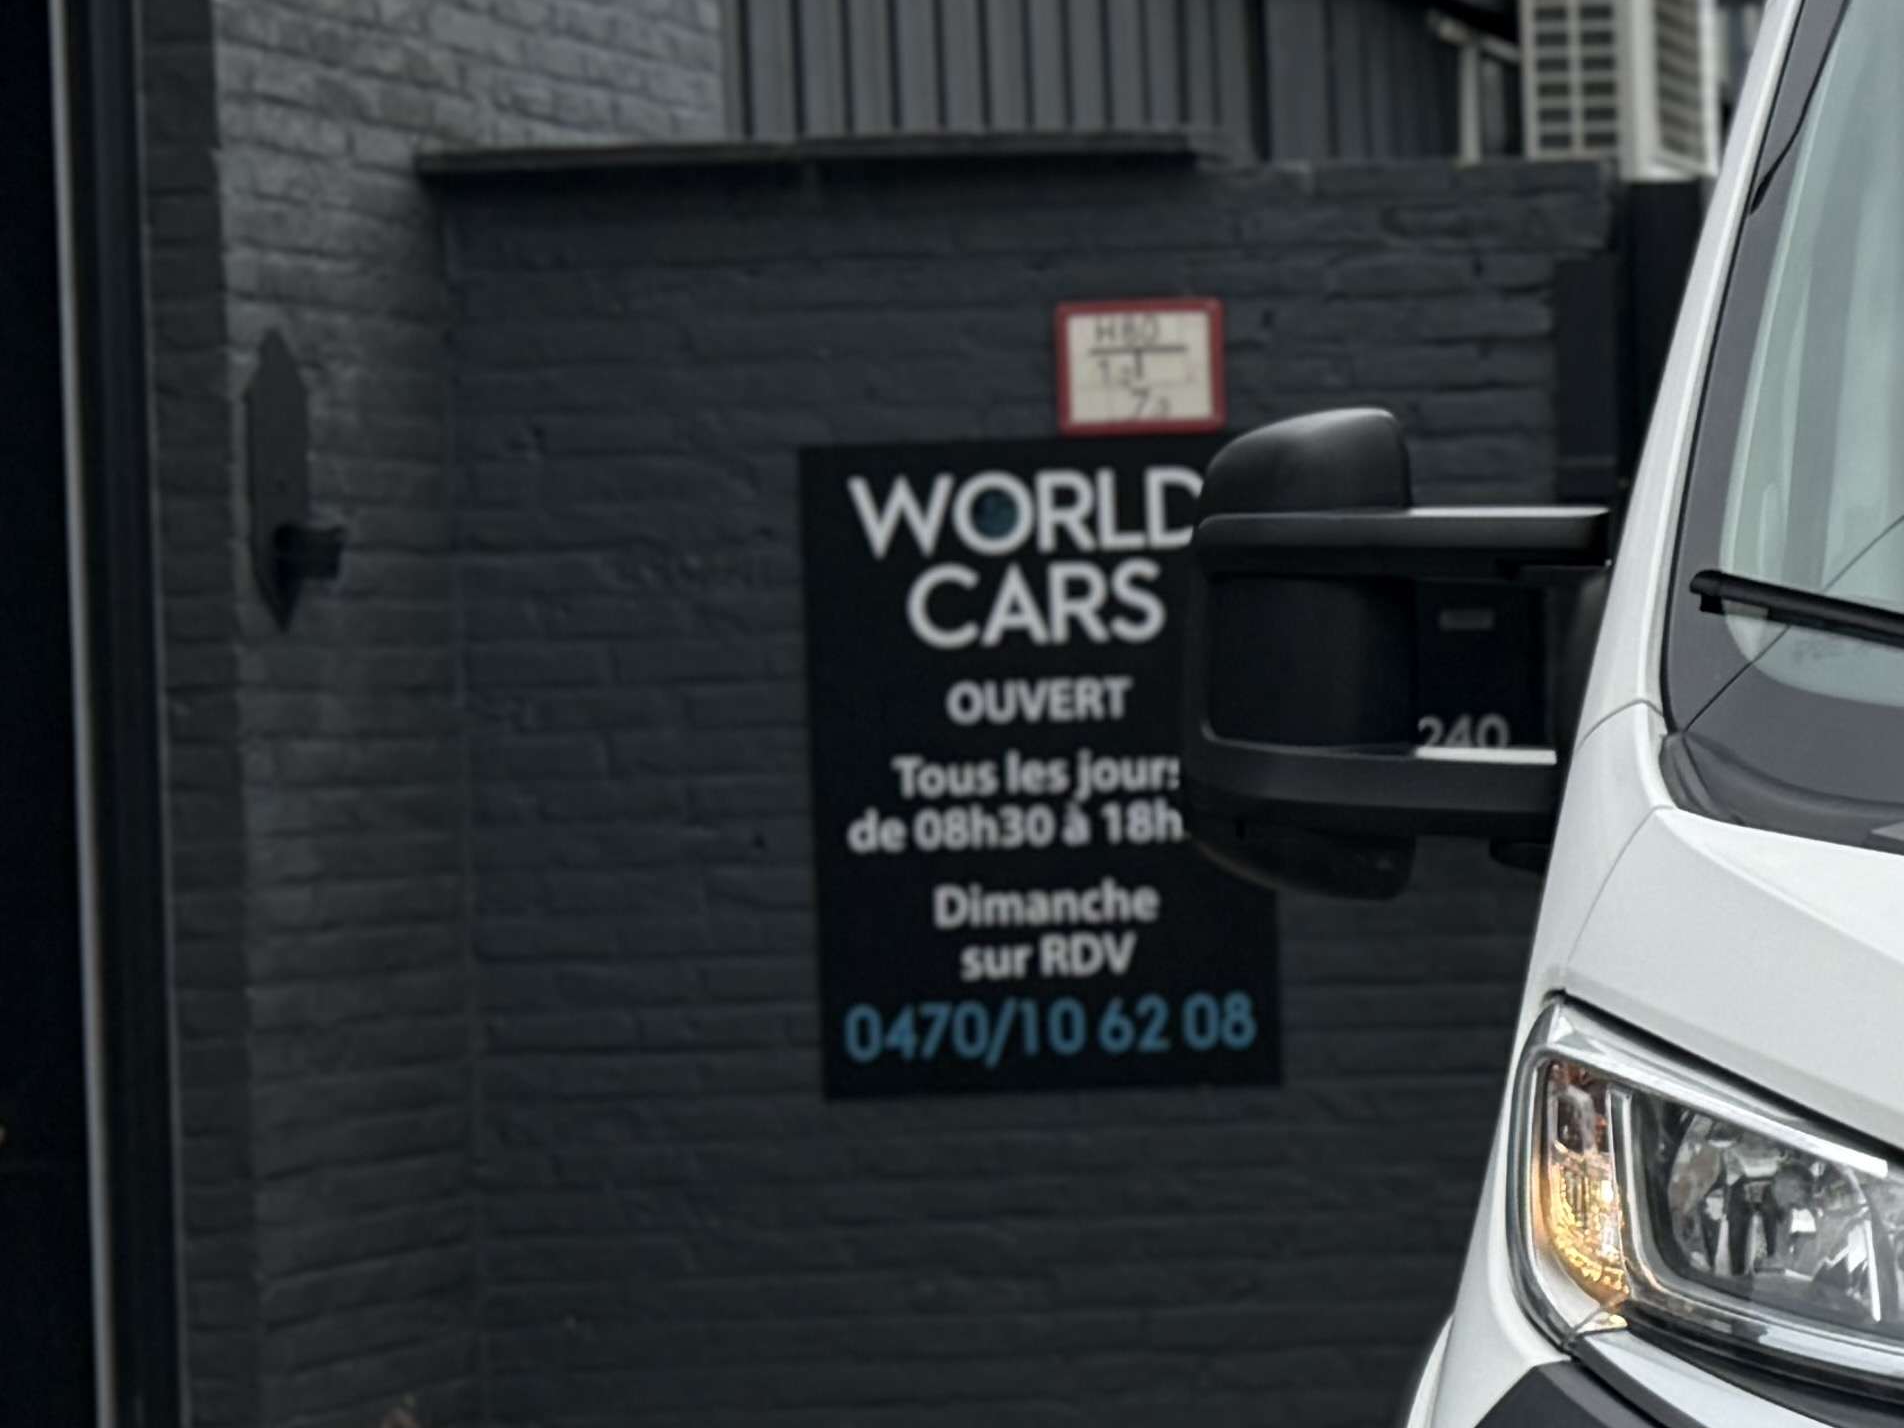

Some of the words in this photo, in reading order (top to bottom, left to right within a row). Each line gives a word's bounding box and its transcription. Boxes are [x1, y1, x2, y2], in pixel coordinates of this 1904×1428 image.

[847, 465, 1204, 560] WORLD
[906, 557, 1167, 650] CARS
[945, 676, 1133, 725] OUVERT
[1418, 713, 1510, 748] 240
[890, 753, 1000, 800] Tous
[1004, 748, 1070, 794] les
[847, 807, 907, 854] de
[913, 803, 1056, 852] 08h30
[1062, 799, 1091, 847] à
[932, 875, 1162, 930] Dimanche
[960, 945, 1034, 982] sur
[1038, 931, 1138, 977] RDV
[844, 996, 1087, 1068] 0470/10
[1099, 993, 1171, 1054] 62
[1182, 989, 1258, 1051] 08
